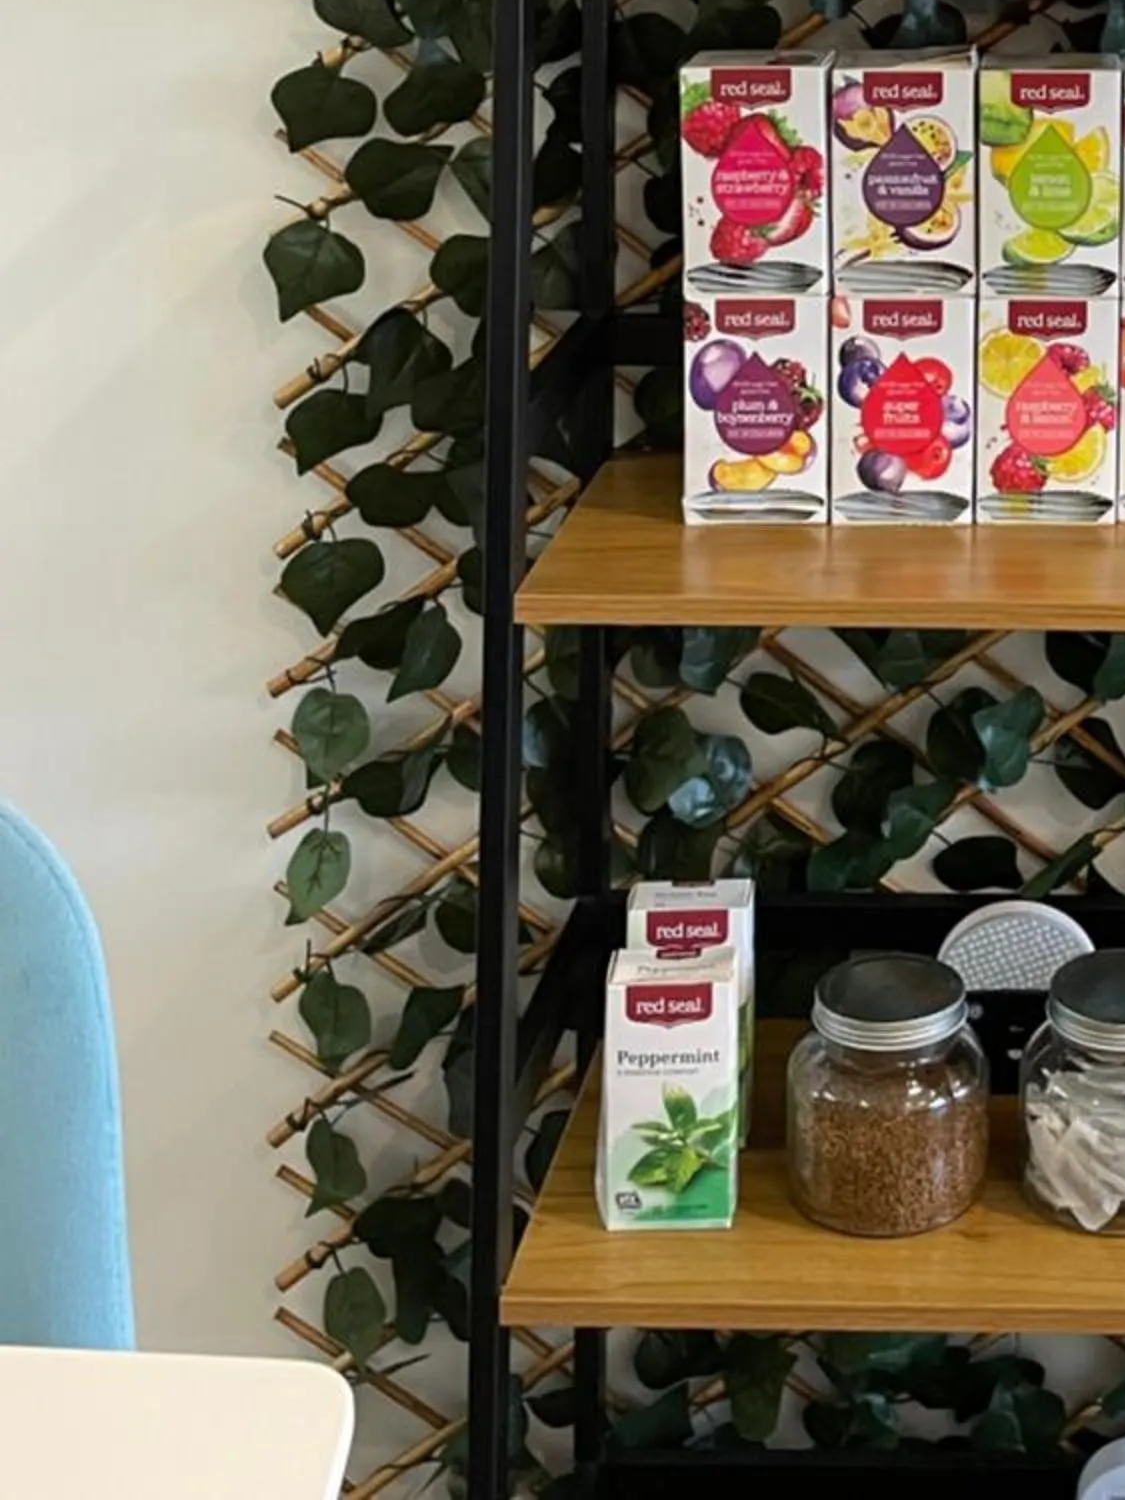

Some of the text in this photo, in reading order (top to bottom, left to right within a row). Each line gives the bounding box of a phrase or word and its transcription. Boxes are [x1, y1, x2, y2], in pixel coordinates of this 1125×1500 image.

[721, 81, 747, 96] red
[872, 84, 899, 99] red
[1020, 85, 1047, 100] red
[716, 182, 788, 197] strawberry
[725, 311, 752, 327] red
[872, 312, 899, 327] red
[1017, 313, 1044, 328] red
[731, 399, 765, 414] plum
[656, 922, 684, 940] red
[636, 998, 665, 1015] red
[617, 1048, 720, 1070] Peppermint
